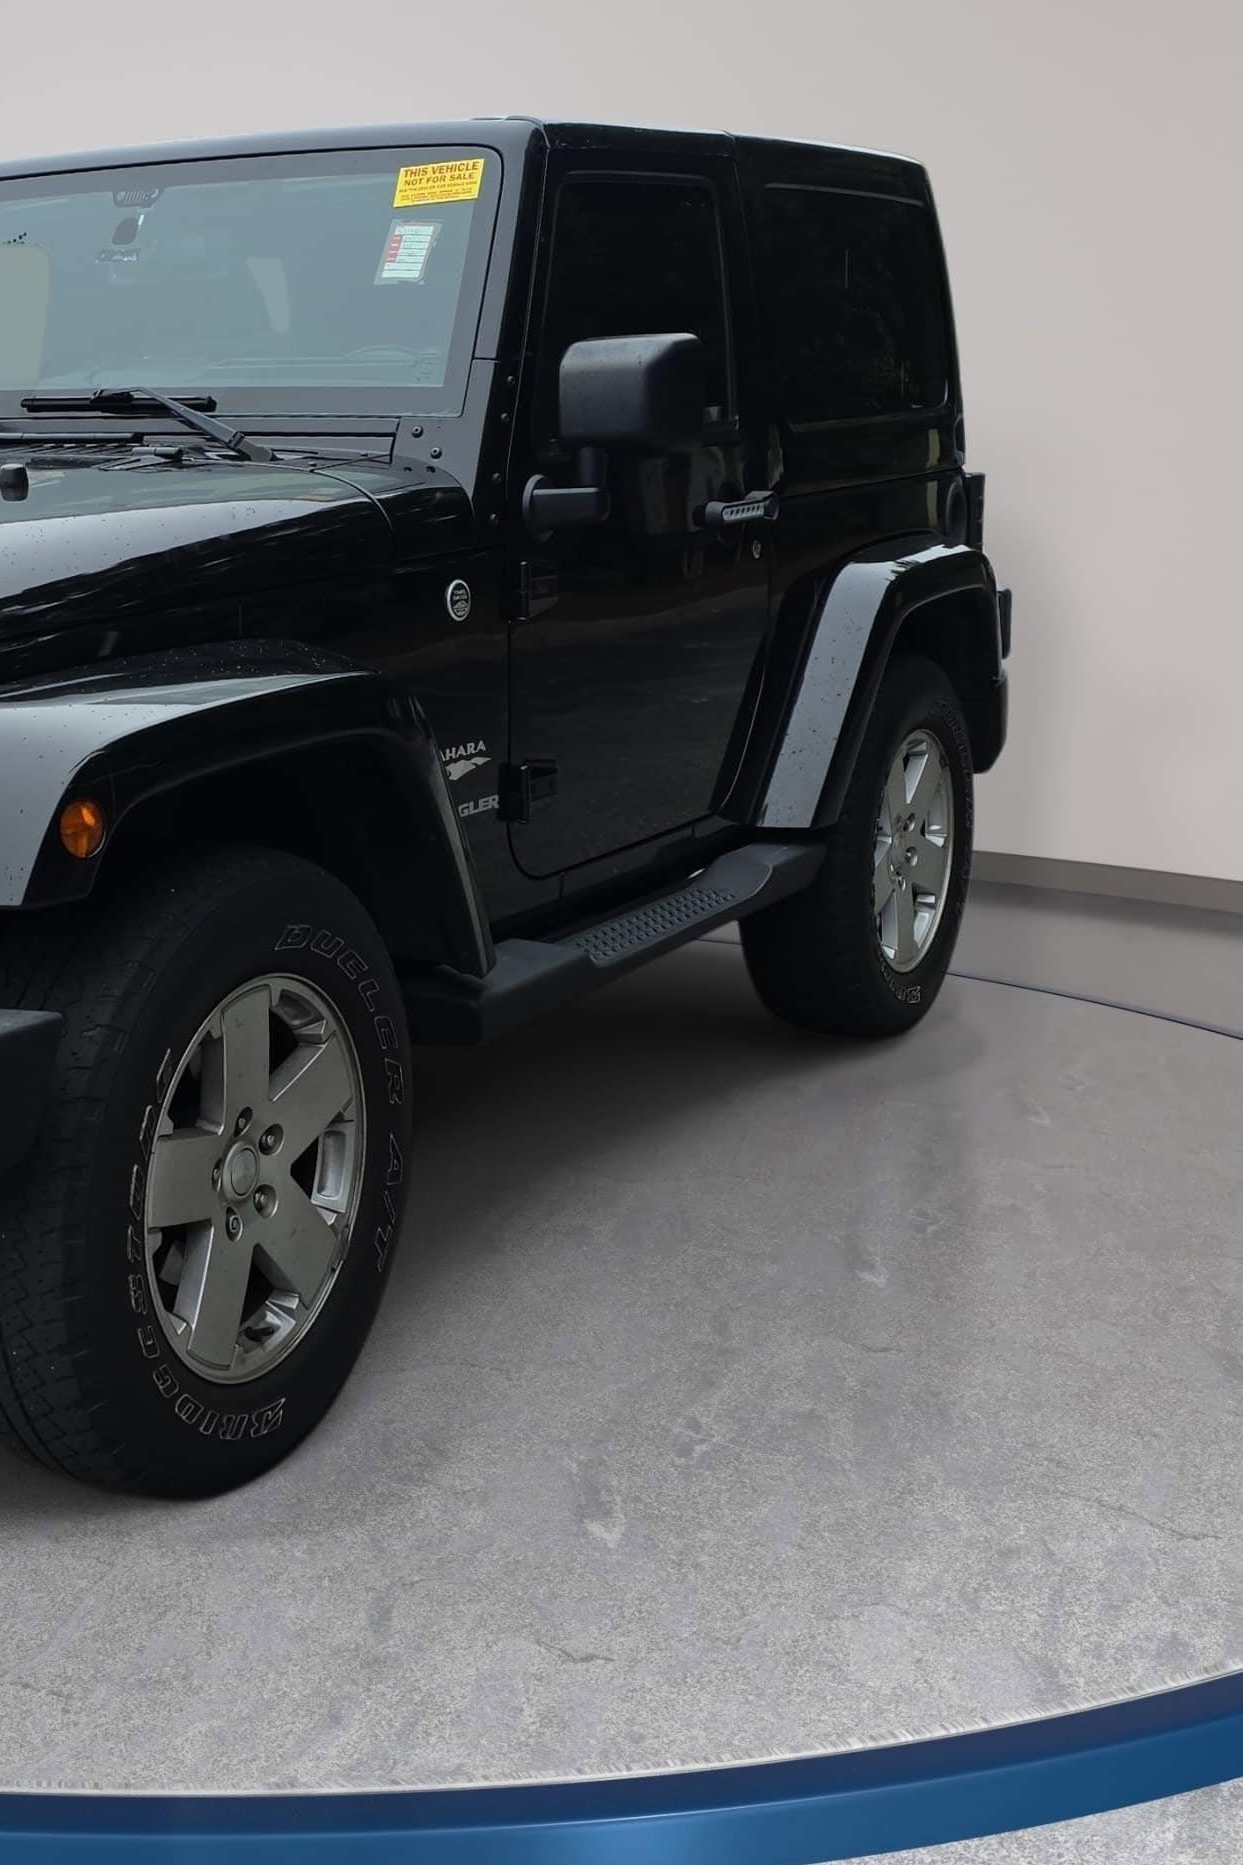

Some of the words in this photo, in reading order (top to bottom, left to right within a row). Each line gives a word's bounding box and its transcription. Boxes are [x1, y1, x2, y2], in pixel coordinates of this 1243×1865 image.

[404, 167, 428, 178] THIS
[432, 162, 479, 174] VEHICLE
[404, 178, 423, 186] NOT
[426, 175, 447, 184] FOR
[449, 172, 475, 181] SALE
[275, 924, 406, 1105] DUELER
